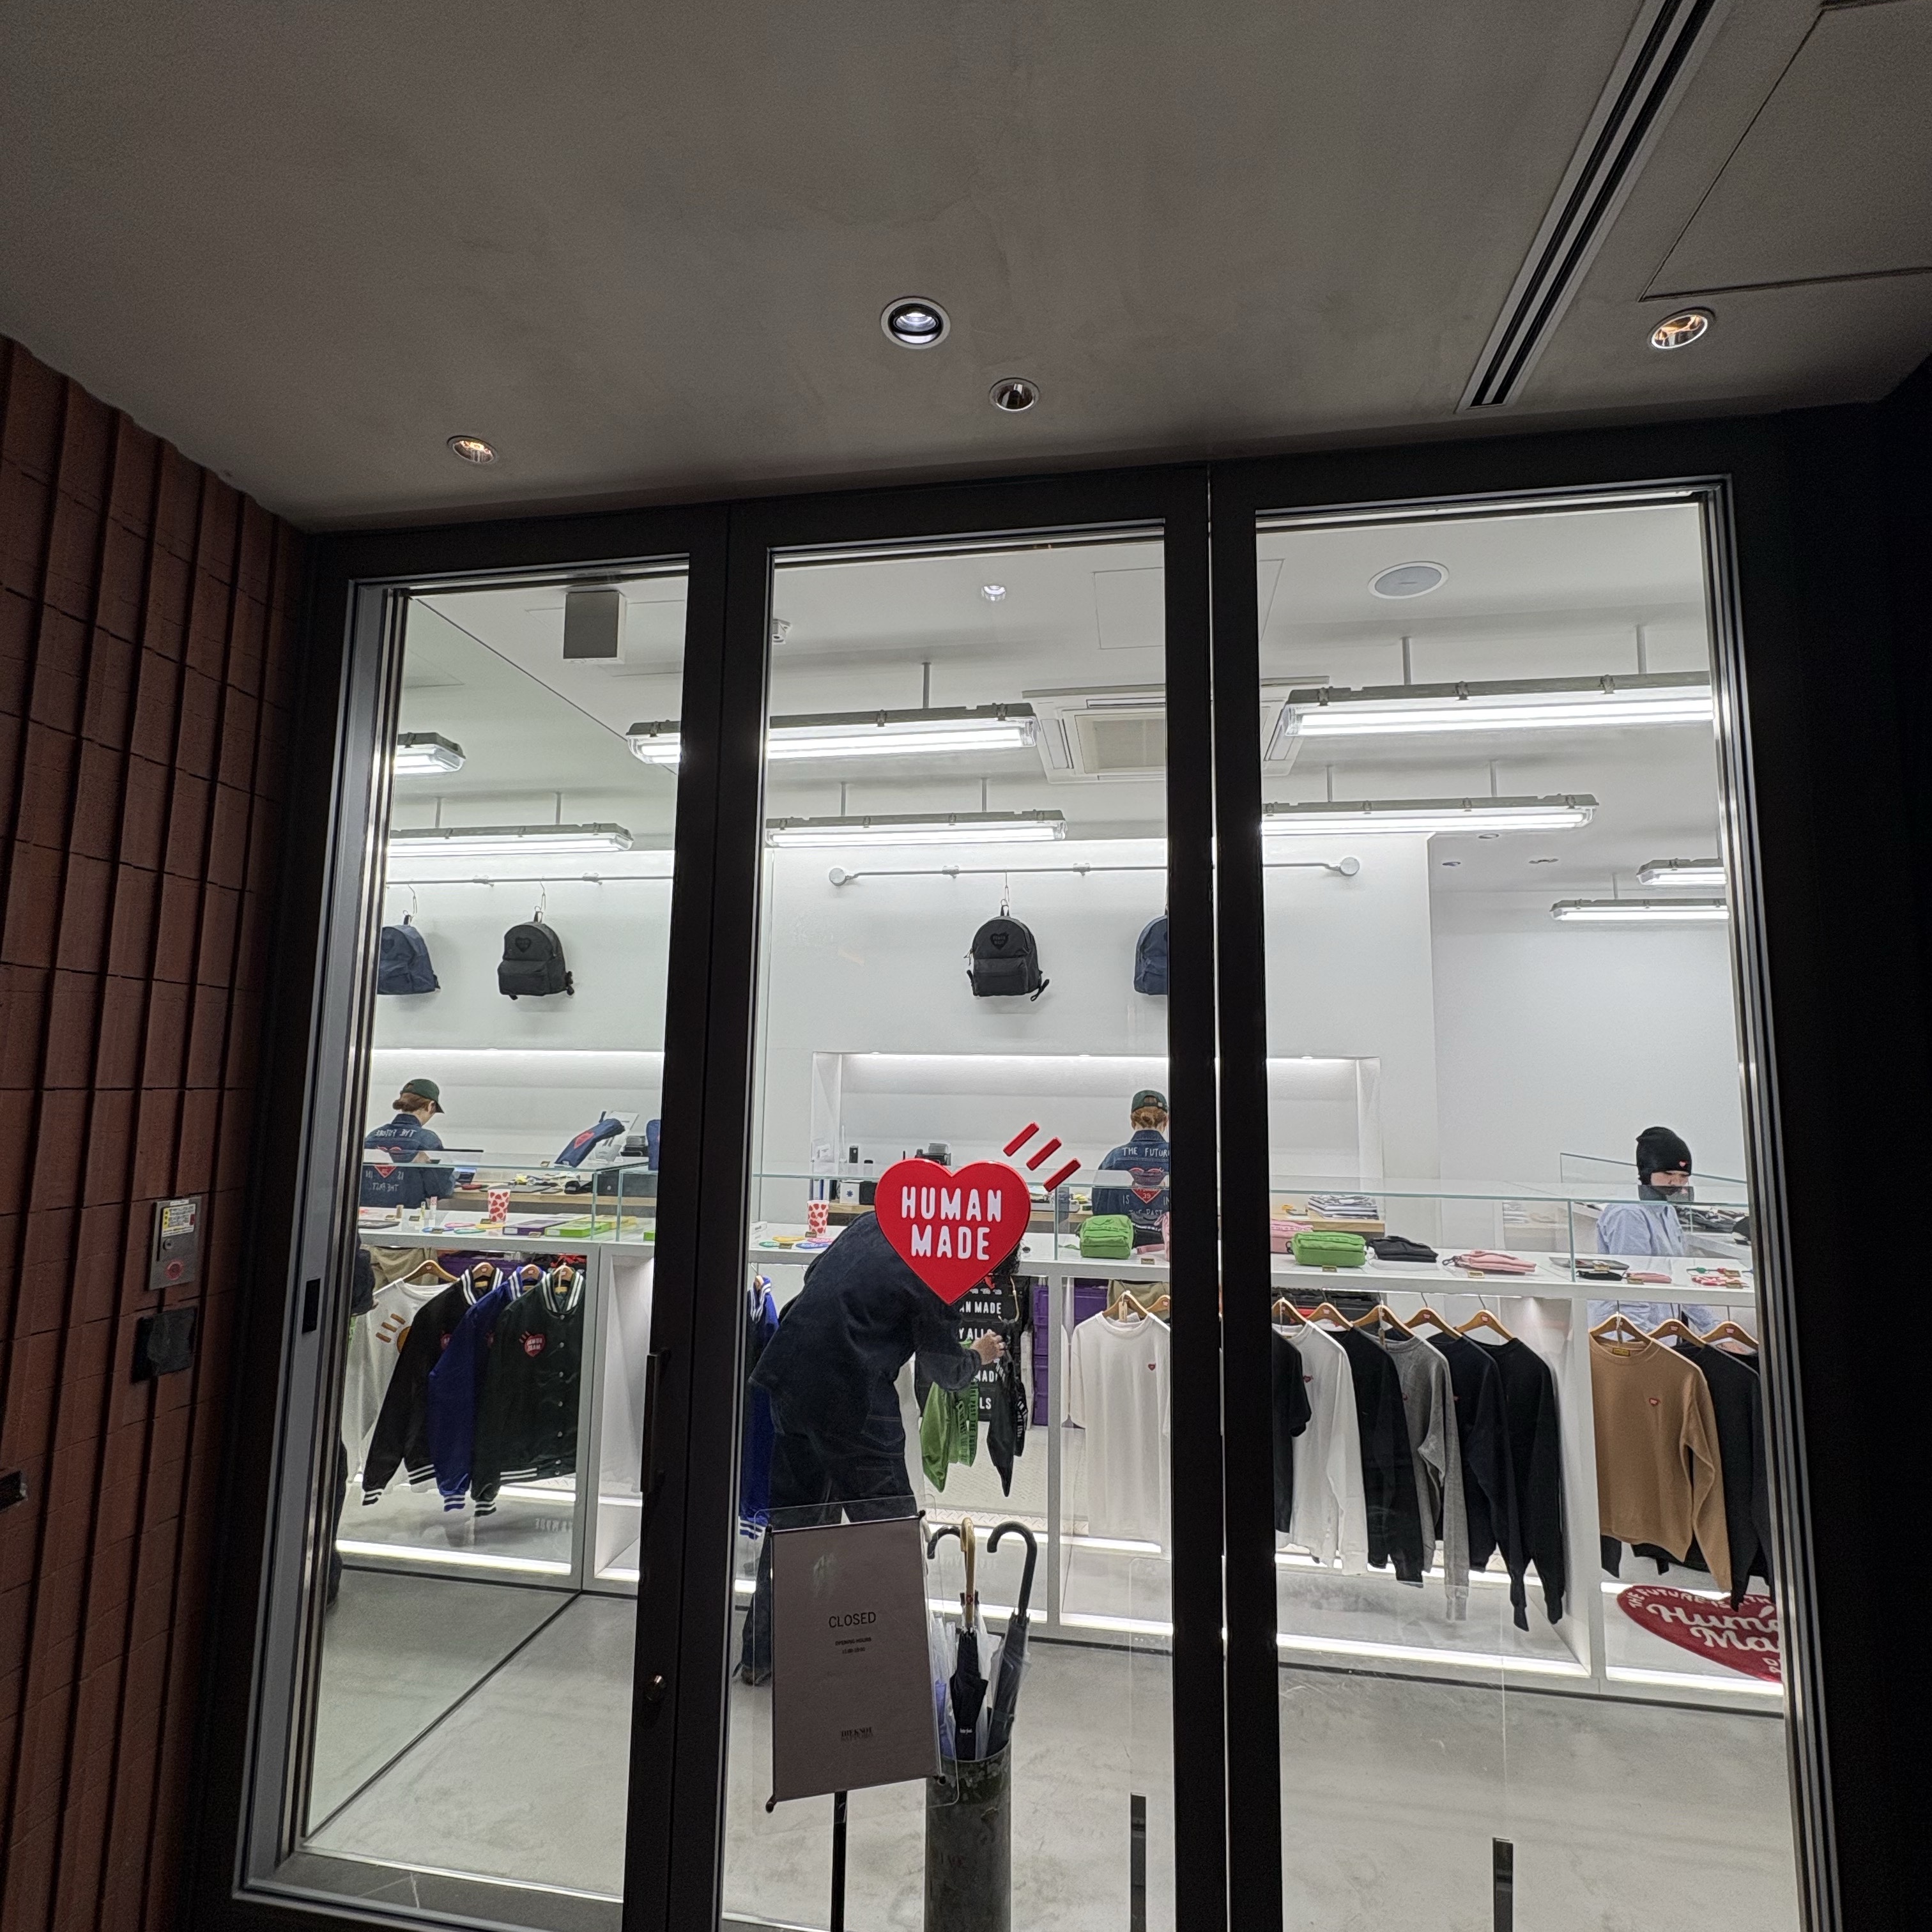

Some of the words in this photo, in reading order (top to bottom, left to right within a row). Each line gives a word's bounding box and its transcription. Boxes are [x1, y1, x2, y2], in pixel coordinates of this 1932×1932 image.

[1123, 1147, 1138, 1156] THE
[1145, 1148, 1169, 1157] FUTUR
[901, 1186, 1002, 1222] HUMAN
[1123, 1195, 1130, 1204] IS
[911, 1223, 990, 1261] MADE
[974, 1301, 1002, 1314] MADE
[1636, 1588, 1705, 1604] FUTURE
[829, 1611, 876, 1628] CLOSED
